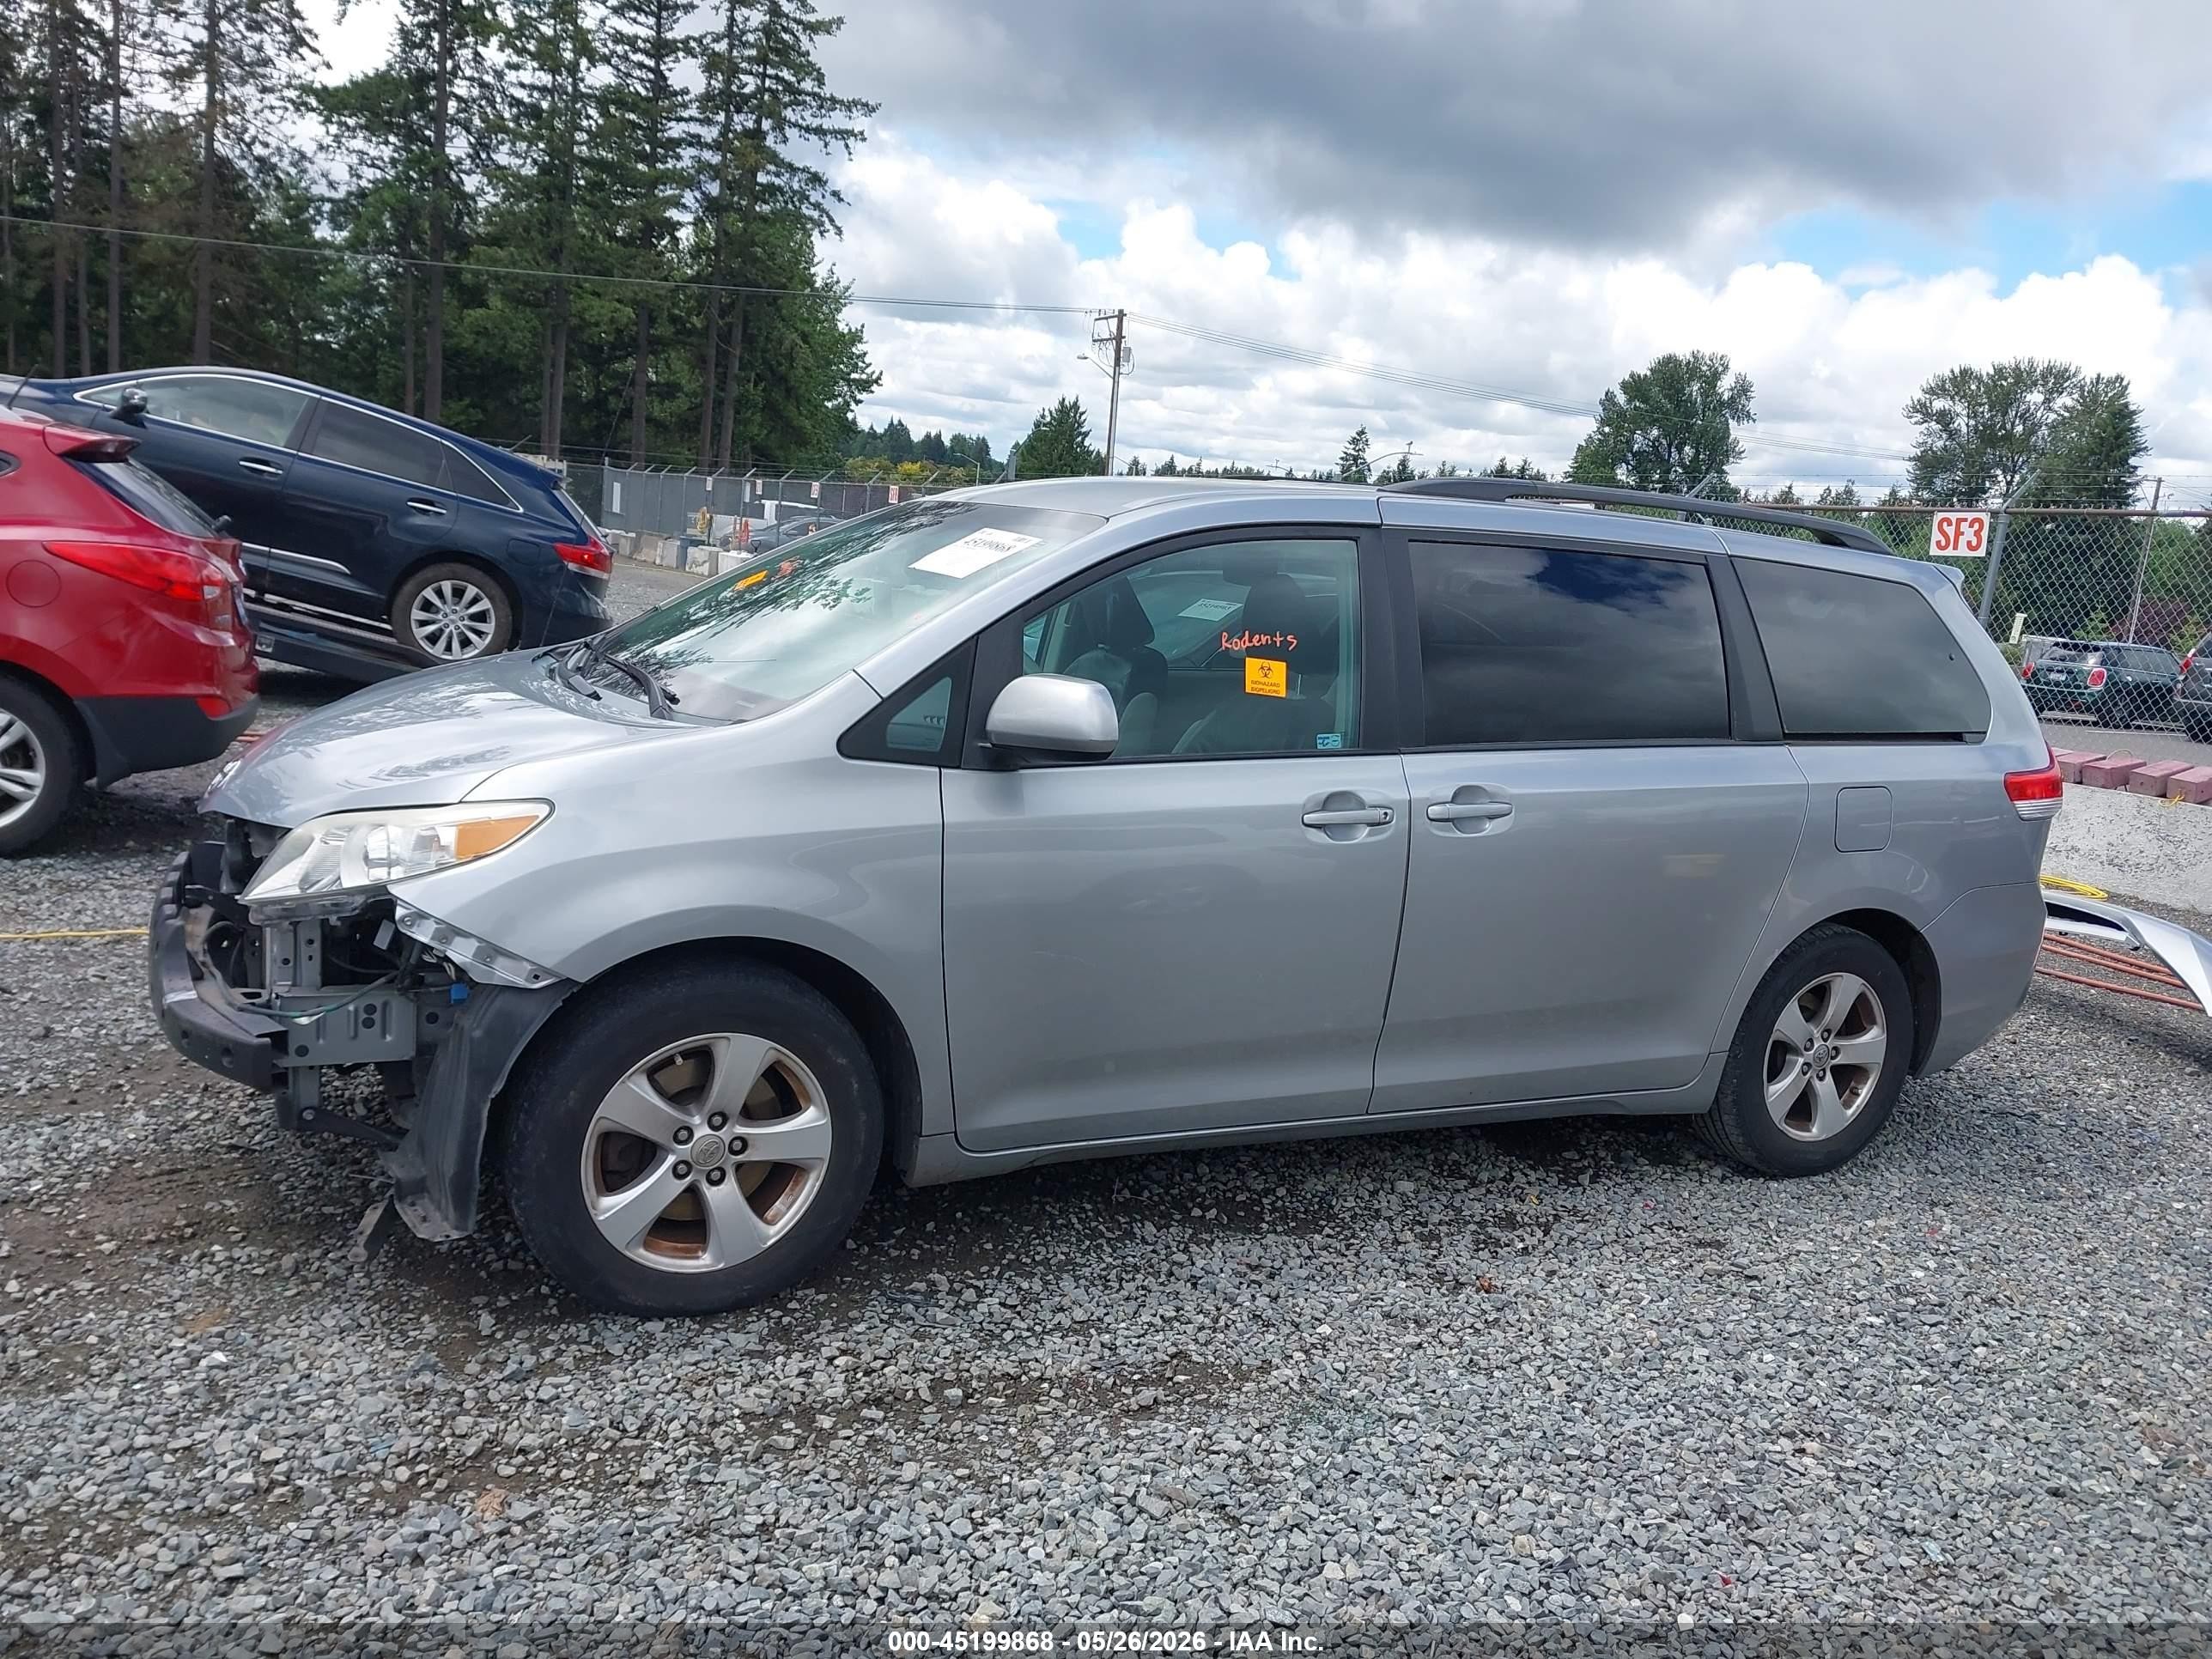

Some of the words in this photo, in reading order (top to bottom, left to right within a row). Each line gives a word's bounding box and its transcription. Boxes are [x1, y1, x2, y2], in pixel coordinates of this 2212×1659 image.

[1936, 517, 1984, 551] SF3
[1222, 630, 1297, 651] Rodents
[1251, 679, 1280, 688] BIOHAZARD
